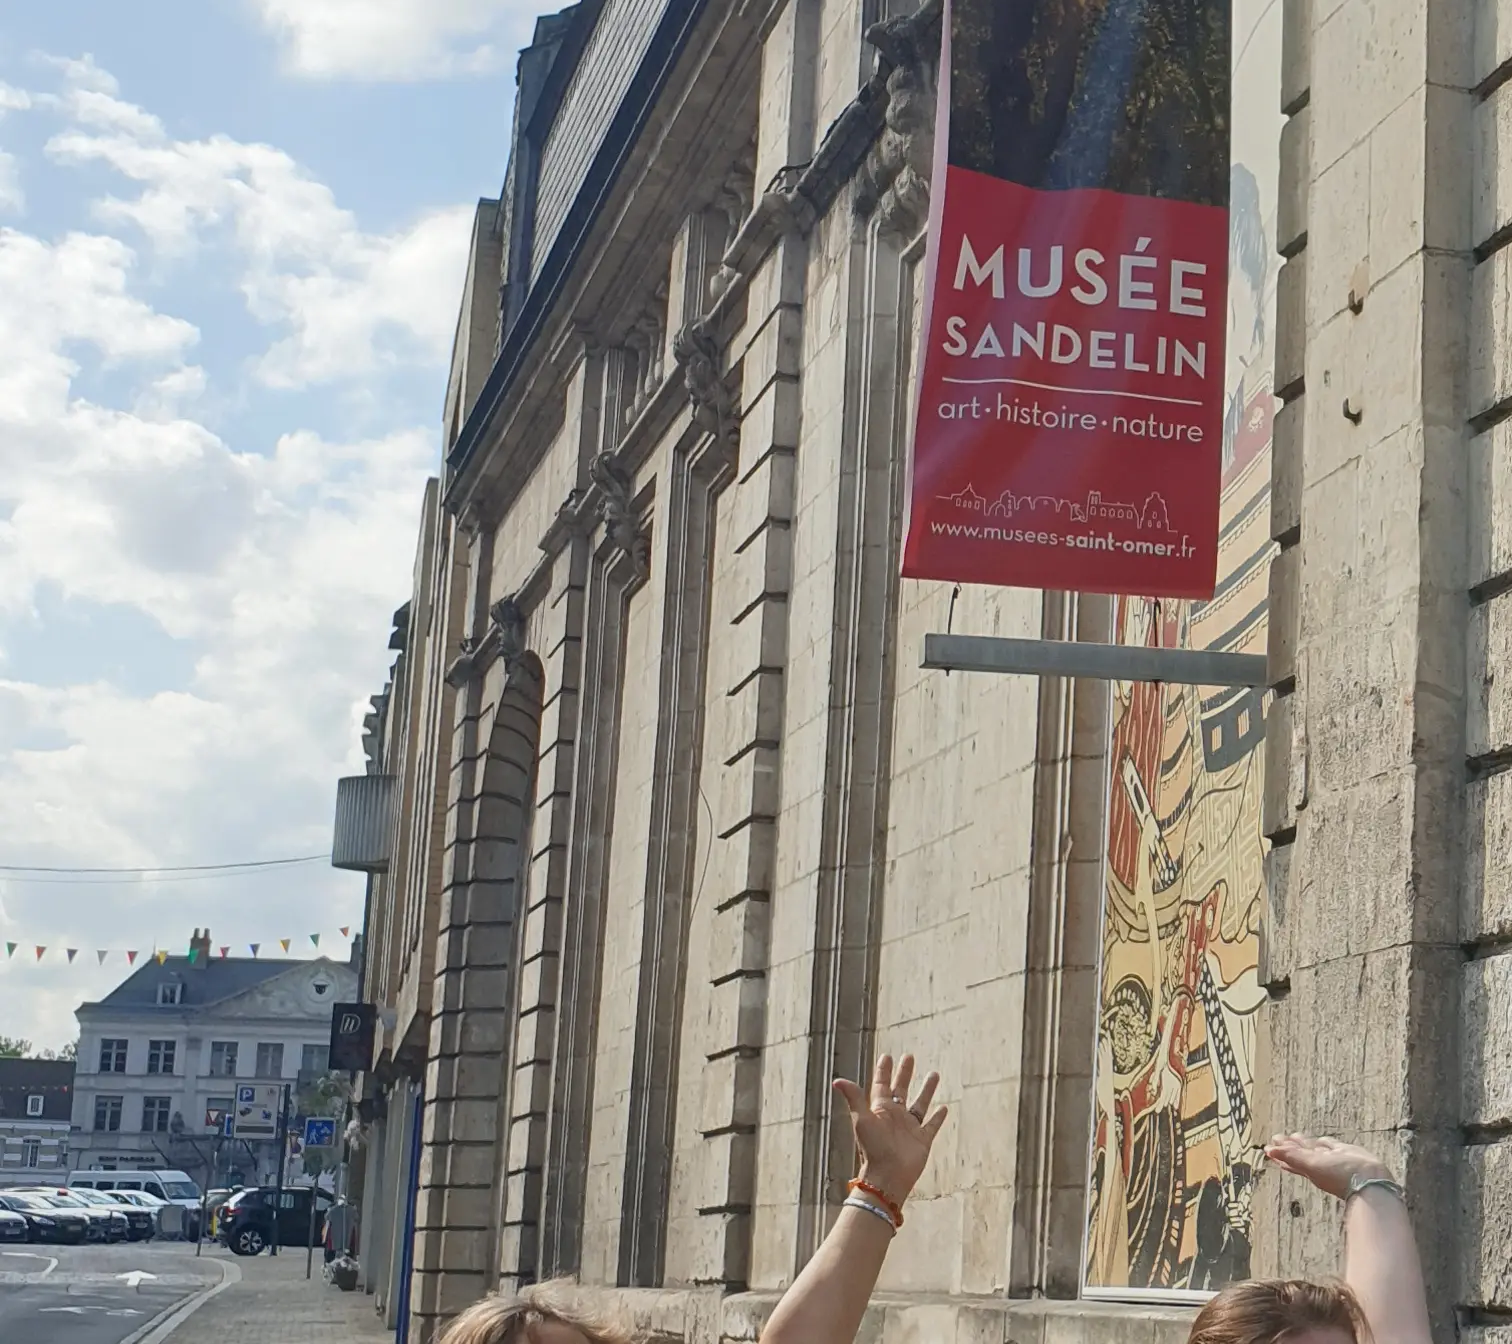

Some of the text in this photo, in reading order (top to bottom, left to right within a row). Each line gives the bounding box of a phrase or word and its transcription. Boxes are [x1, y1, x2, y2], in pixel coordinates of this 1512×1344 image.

[953, 233, 1207, 317] MUSÉE
[942, 316, 1206, 379] SANDELIN
[931, 521, 1197, 558] www.musees-saint-omer.fr
